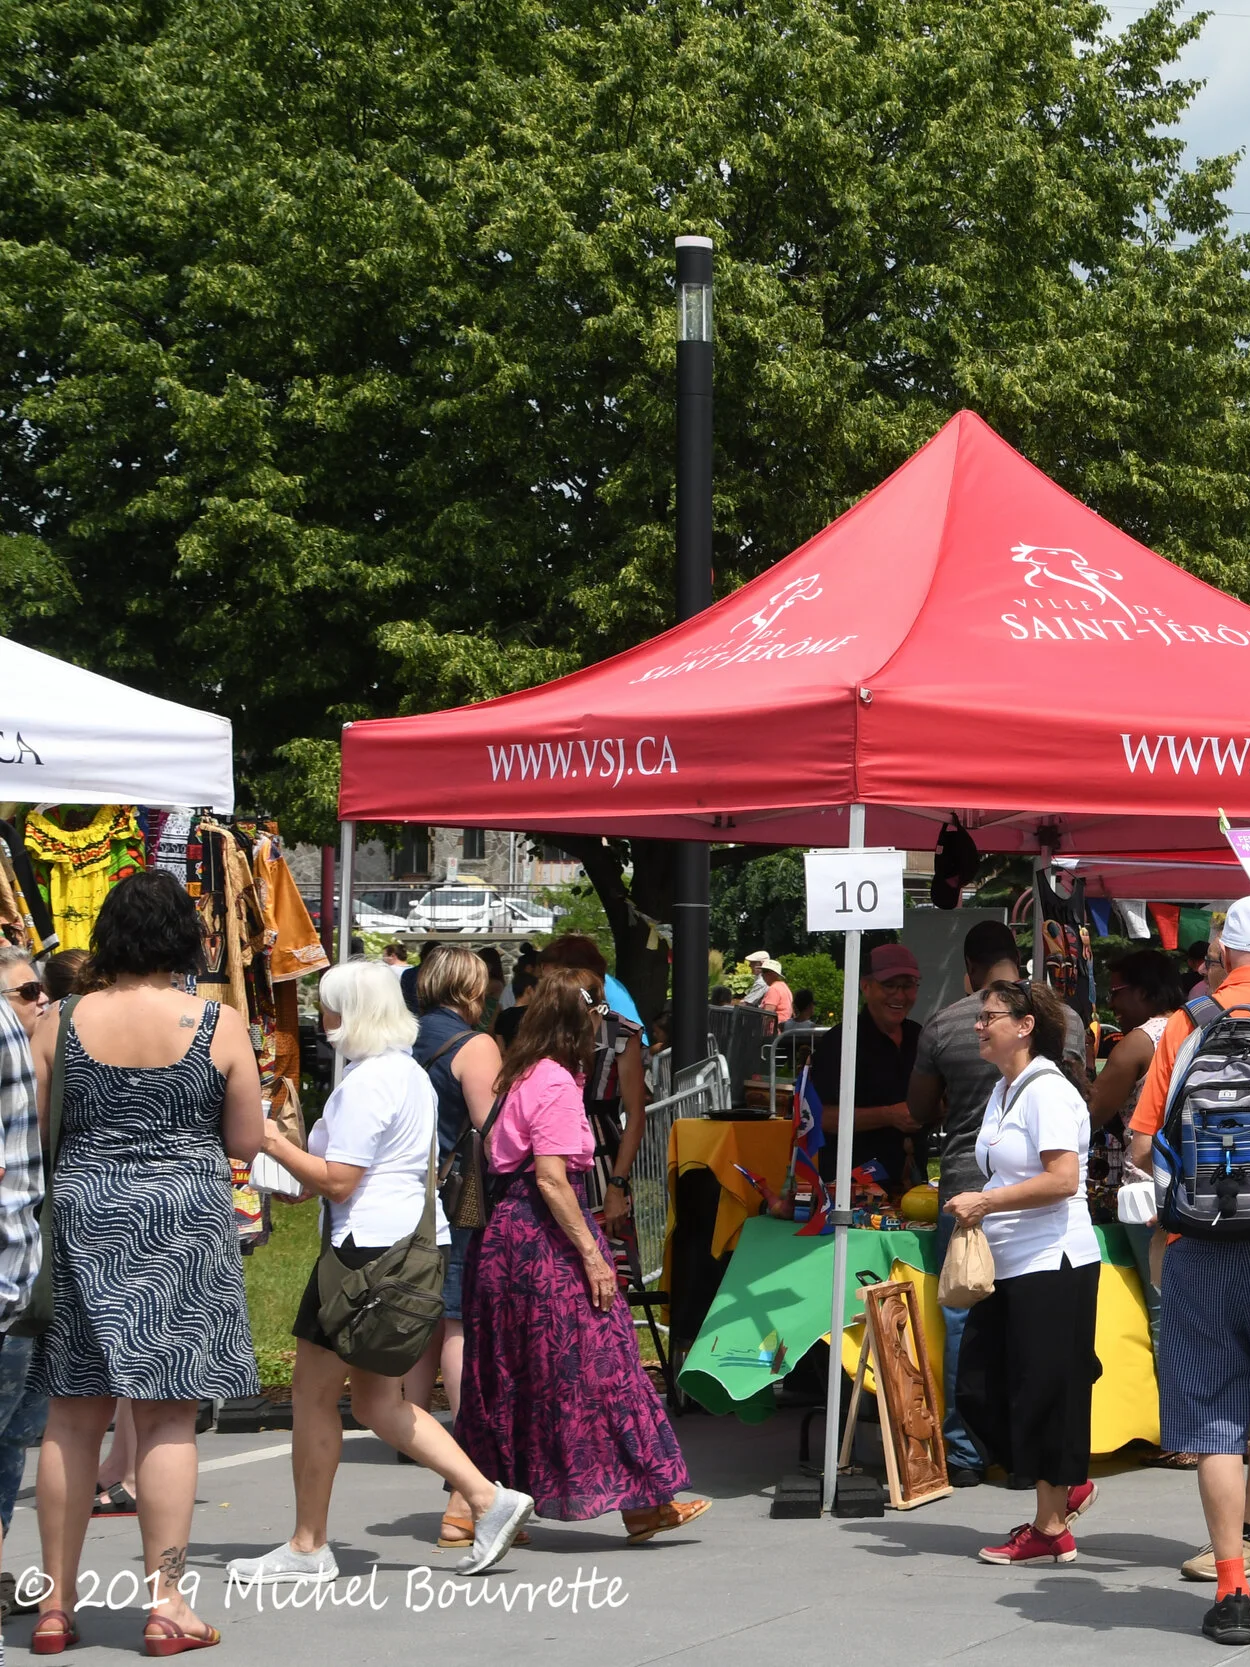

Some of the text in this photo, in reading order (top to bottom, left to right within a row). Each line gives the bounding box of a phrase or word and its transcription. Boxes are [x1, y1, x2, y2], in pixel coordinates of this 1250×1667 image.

[1014, 598, 1166, 617] VILLE DE
[757, 628, 788, 640] DE
[628, 635, 859, 685] SAINT-JÉRÔME
[486, 735, 679, 788] WWW.VSJ.CA
[834, 880, 879, 913] 10
